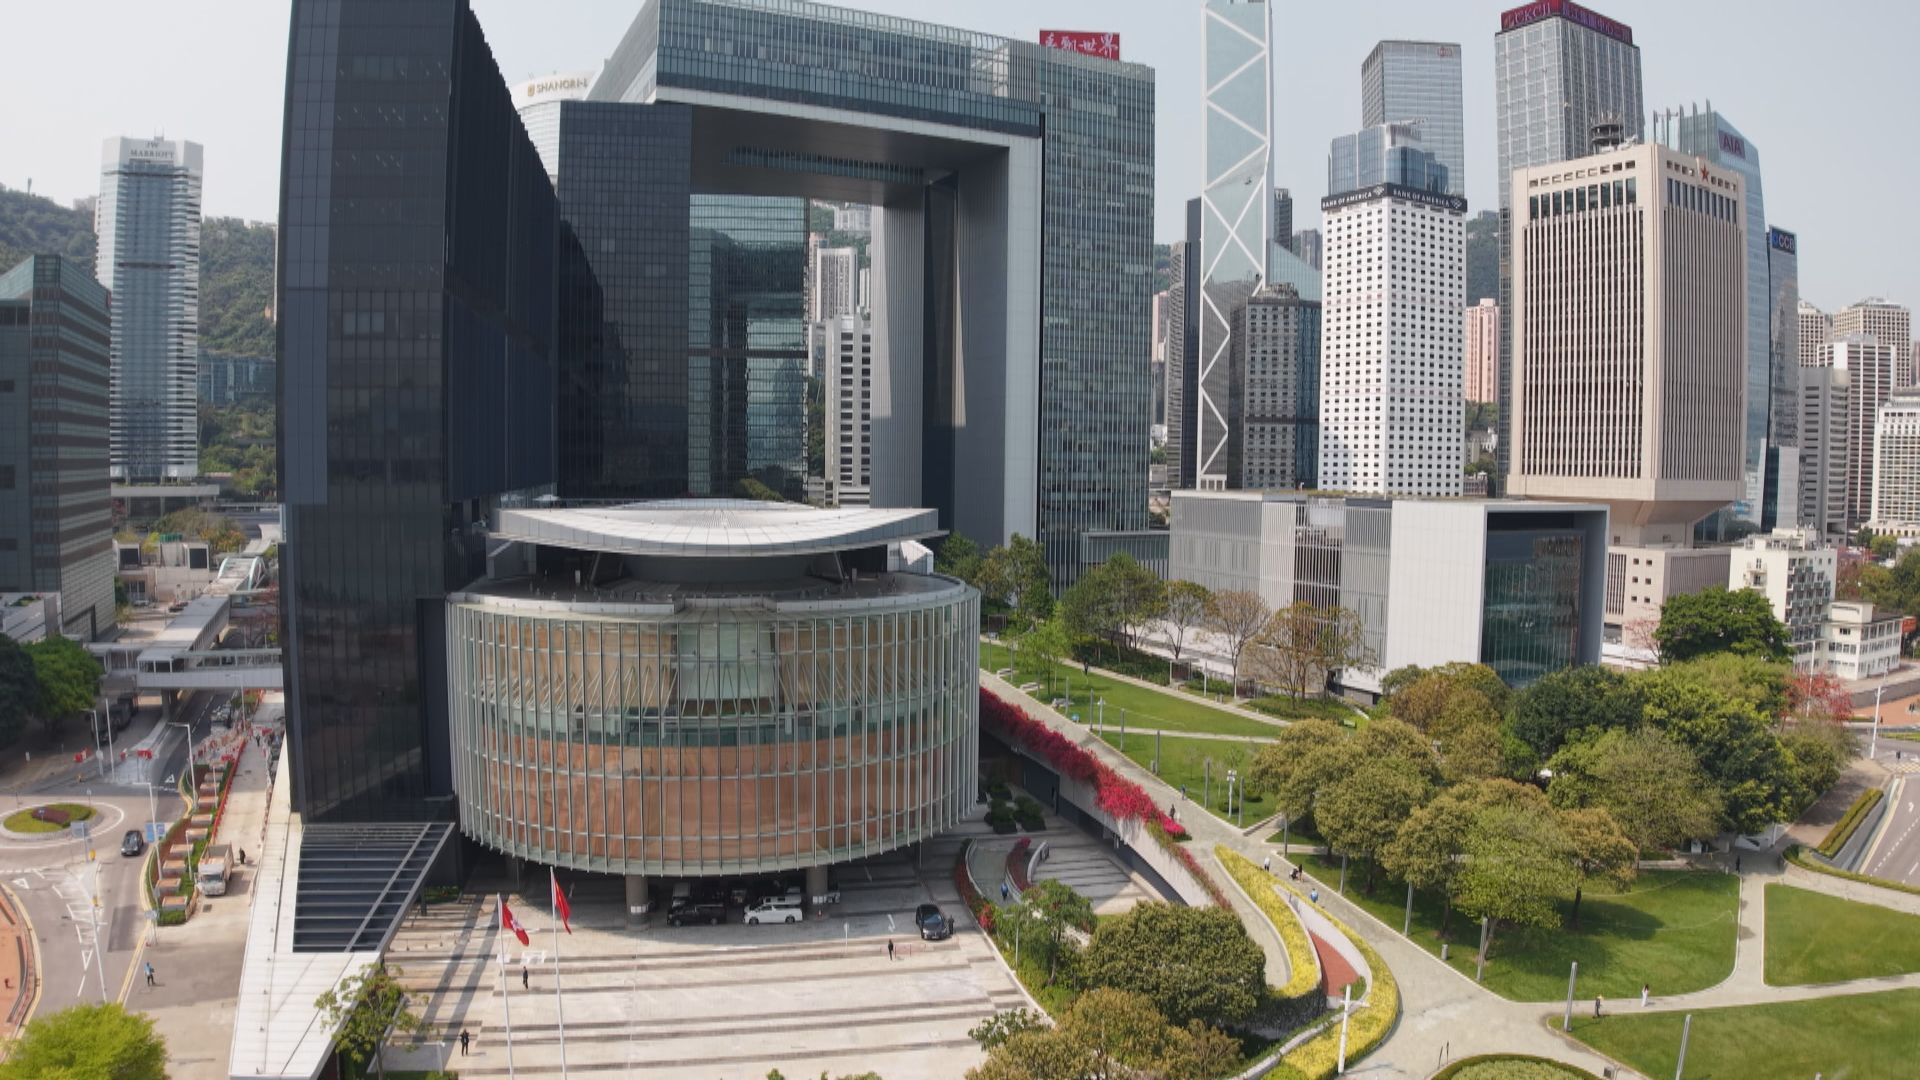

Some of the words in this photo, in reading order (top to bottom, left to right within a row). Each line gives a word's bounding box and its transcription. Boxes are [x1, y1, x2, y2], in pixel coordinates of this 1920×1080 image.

[1723, 133, 1743, 156] AIA
[130, 149, 174, 159] MARRIOTT
[1322, 200, 1337, 209] BANK
[1346, 192, 1372, 203] AMERICA
[1393, 189, 1411, 199] BANK
[1421, 194, 1450, 207] AMERICA
[1778, 233, 1795, 249] CCB
